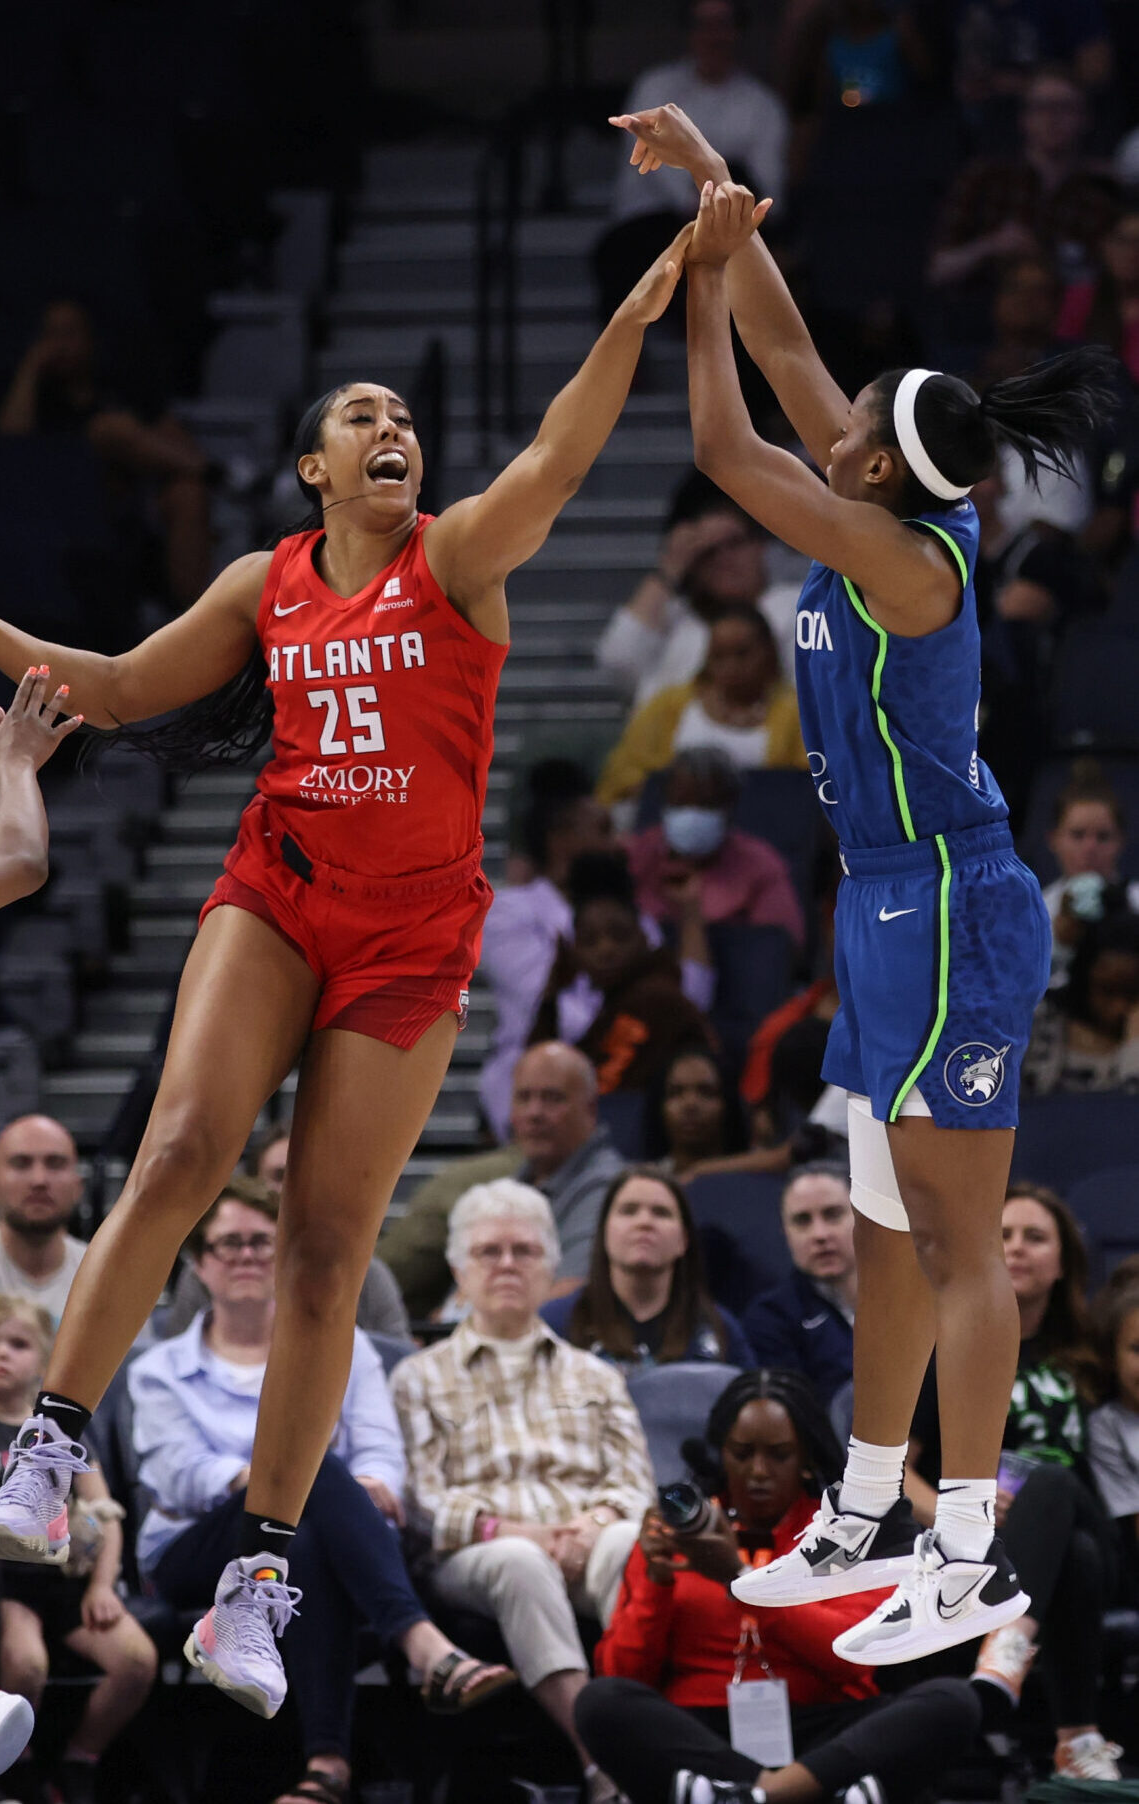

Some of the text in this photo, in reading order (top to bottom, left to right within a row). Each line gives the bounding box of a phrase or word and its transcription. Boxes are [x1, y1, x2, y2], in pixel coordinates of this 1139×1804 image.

[373, 598, 414, 613] Microsoft
[270, 631, 426, 682] ATLANTA
[306, 685, 386, 756] 25
[298, 764, 417, 793] EMORY
[299, 790, 408, 807] HEALTHCARE
